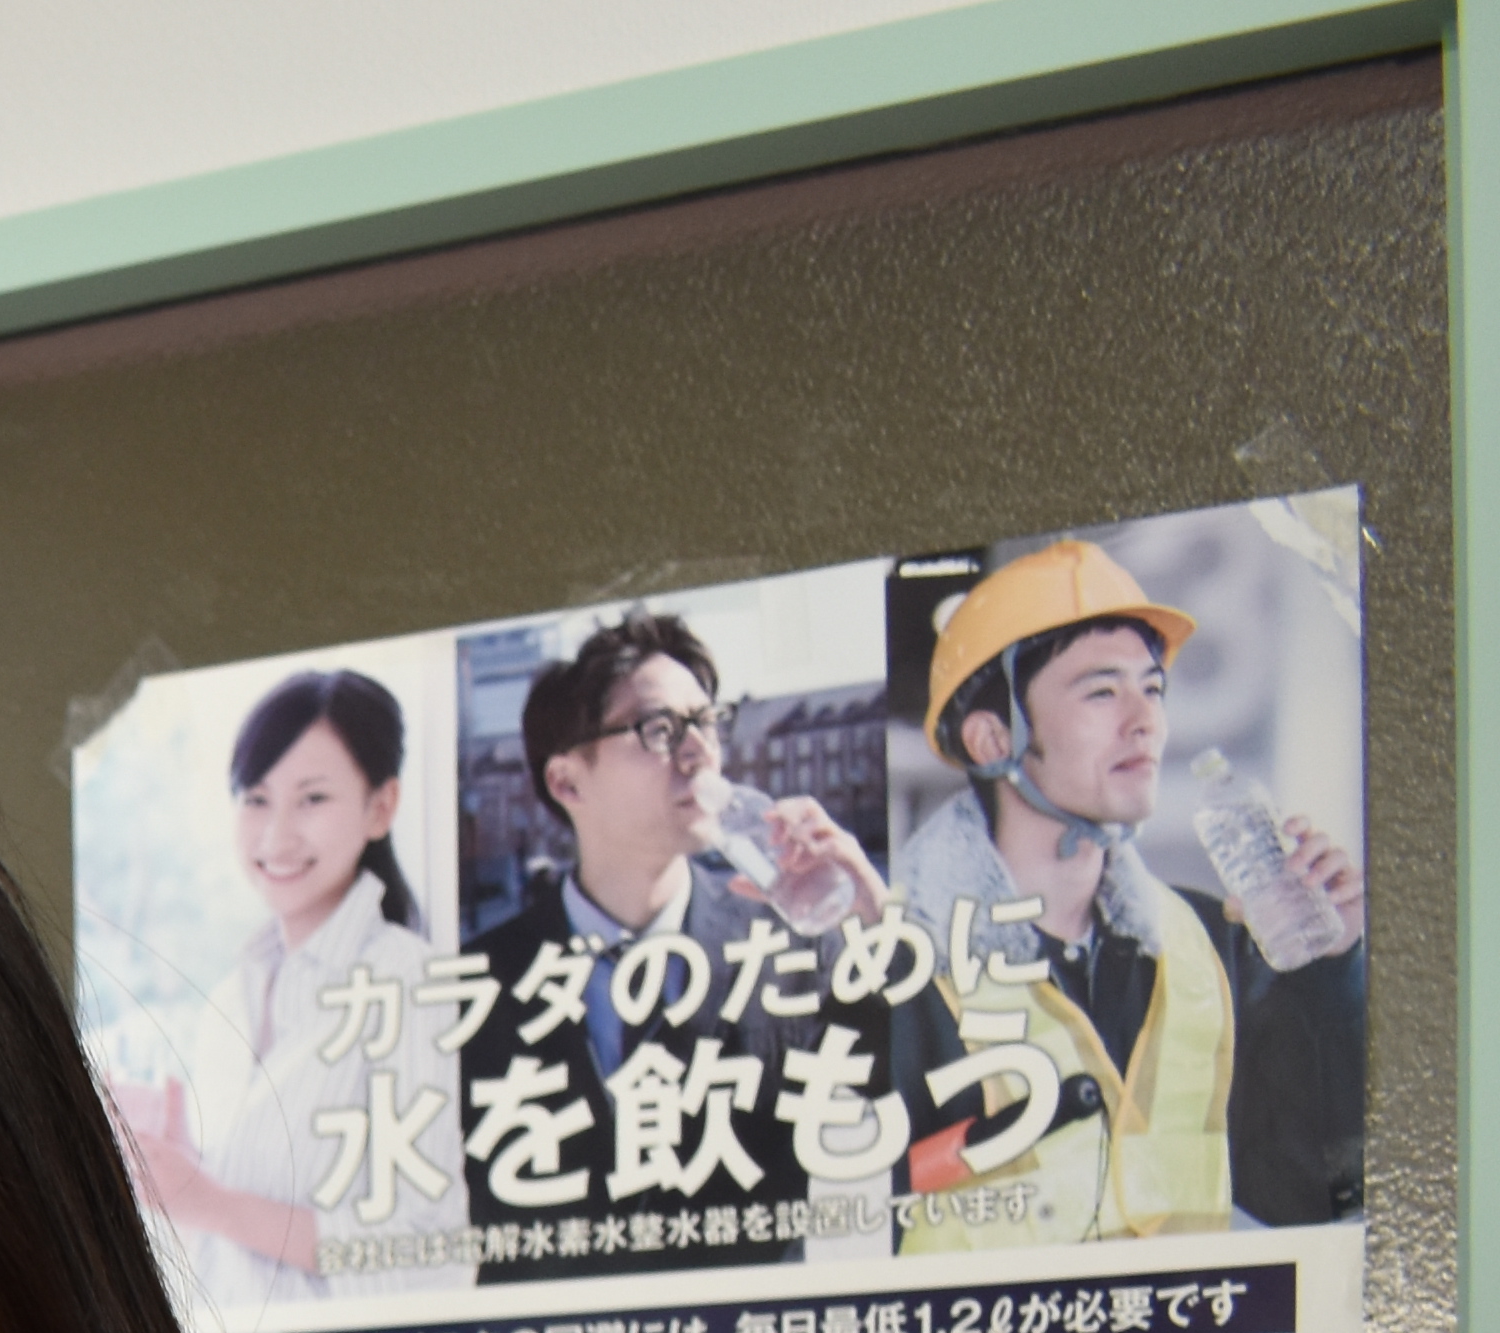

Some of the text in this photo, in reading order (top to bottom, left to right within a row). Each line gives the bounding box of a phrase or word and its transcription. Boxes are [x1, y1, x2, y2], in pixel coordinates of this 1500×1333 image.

[313, 893, 1053, 1068] カラダのために
[307, 1005, 1070, 1227] 水を飲もう
[315, 1182, 1057, 1276] 会社には電解水素水整水器を設置しています。
